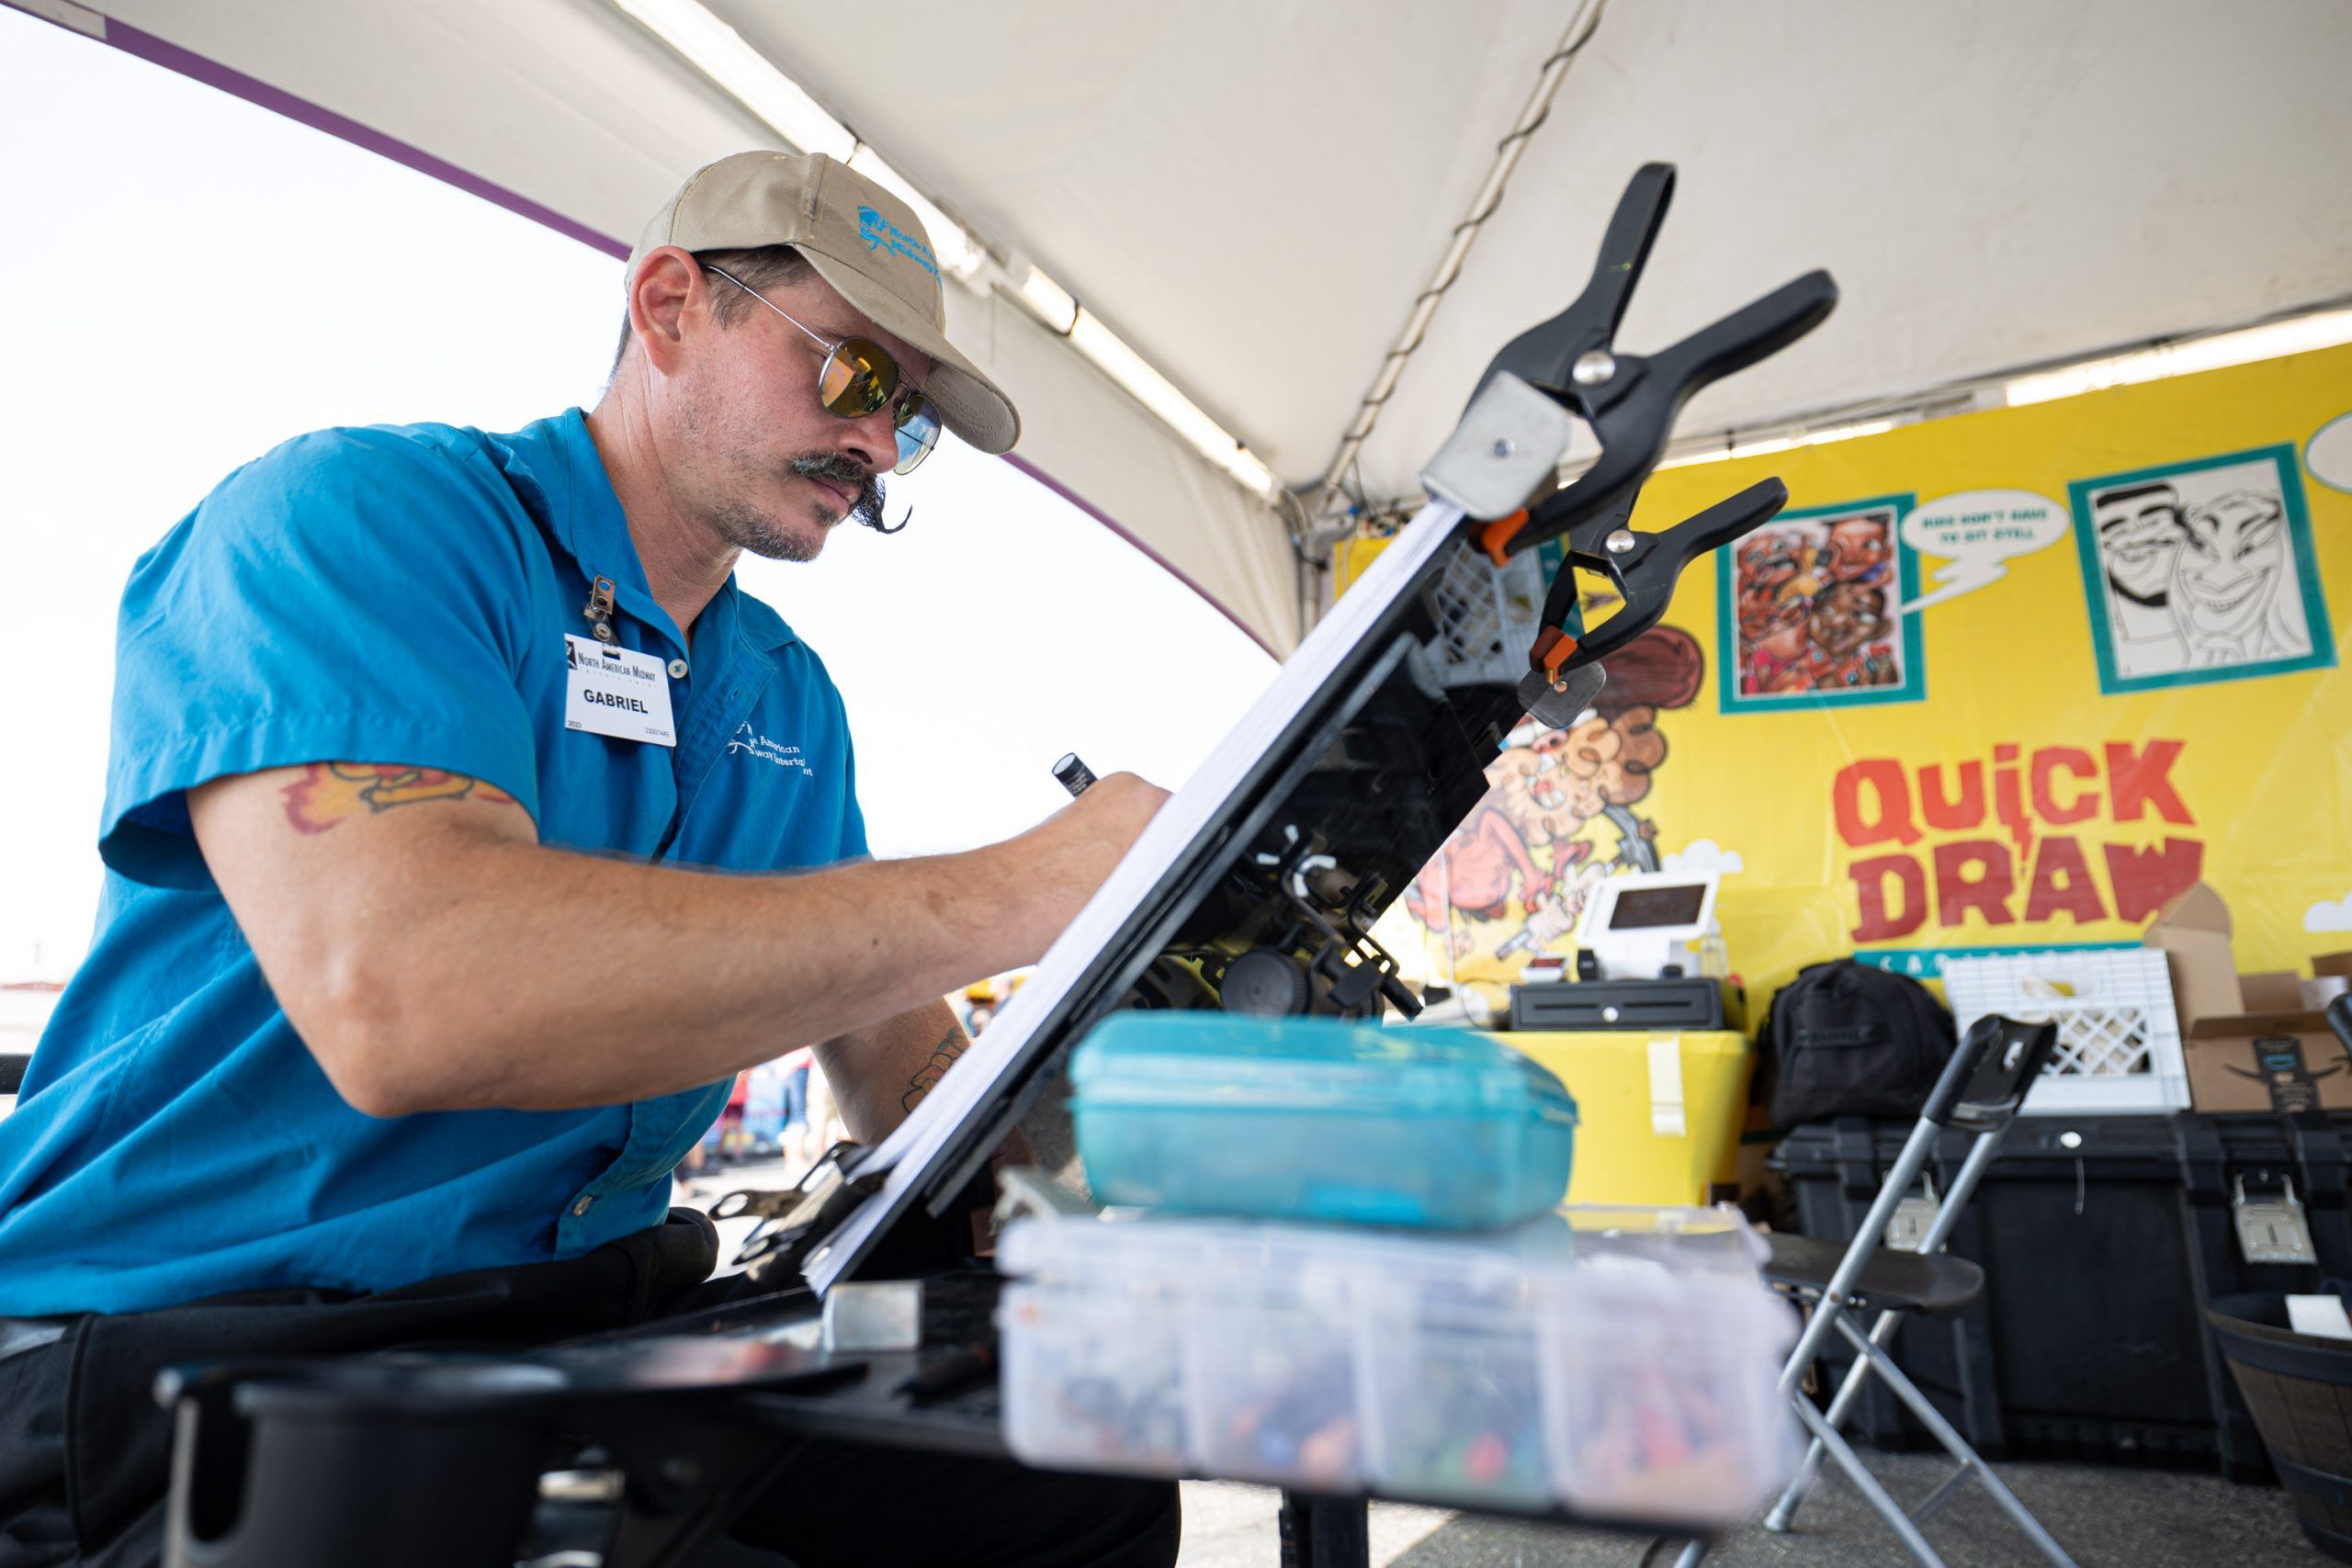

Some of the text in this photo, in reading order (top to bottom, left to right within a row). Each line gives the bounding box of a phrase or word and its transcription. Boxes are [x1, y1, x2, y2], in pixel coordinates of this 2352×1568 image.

[602, 658, 631, 676] AMERICAN
[632, 665, 656, 682] MIDWAY
[583, 689, 649, 715] GABRIEL
[1848, 835, 2205, 944] DRAW
